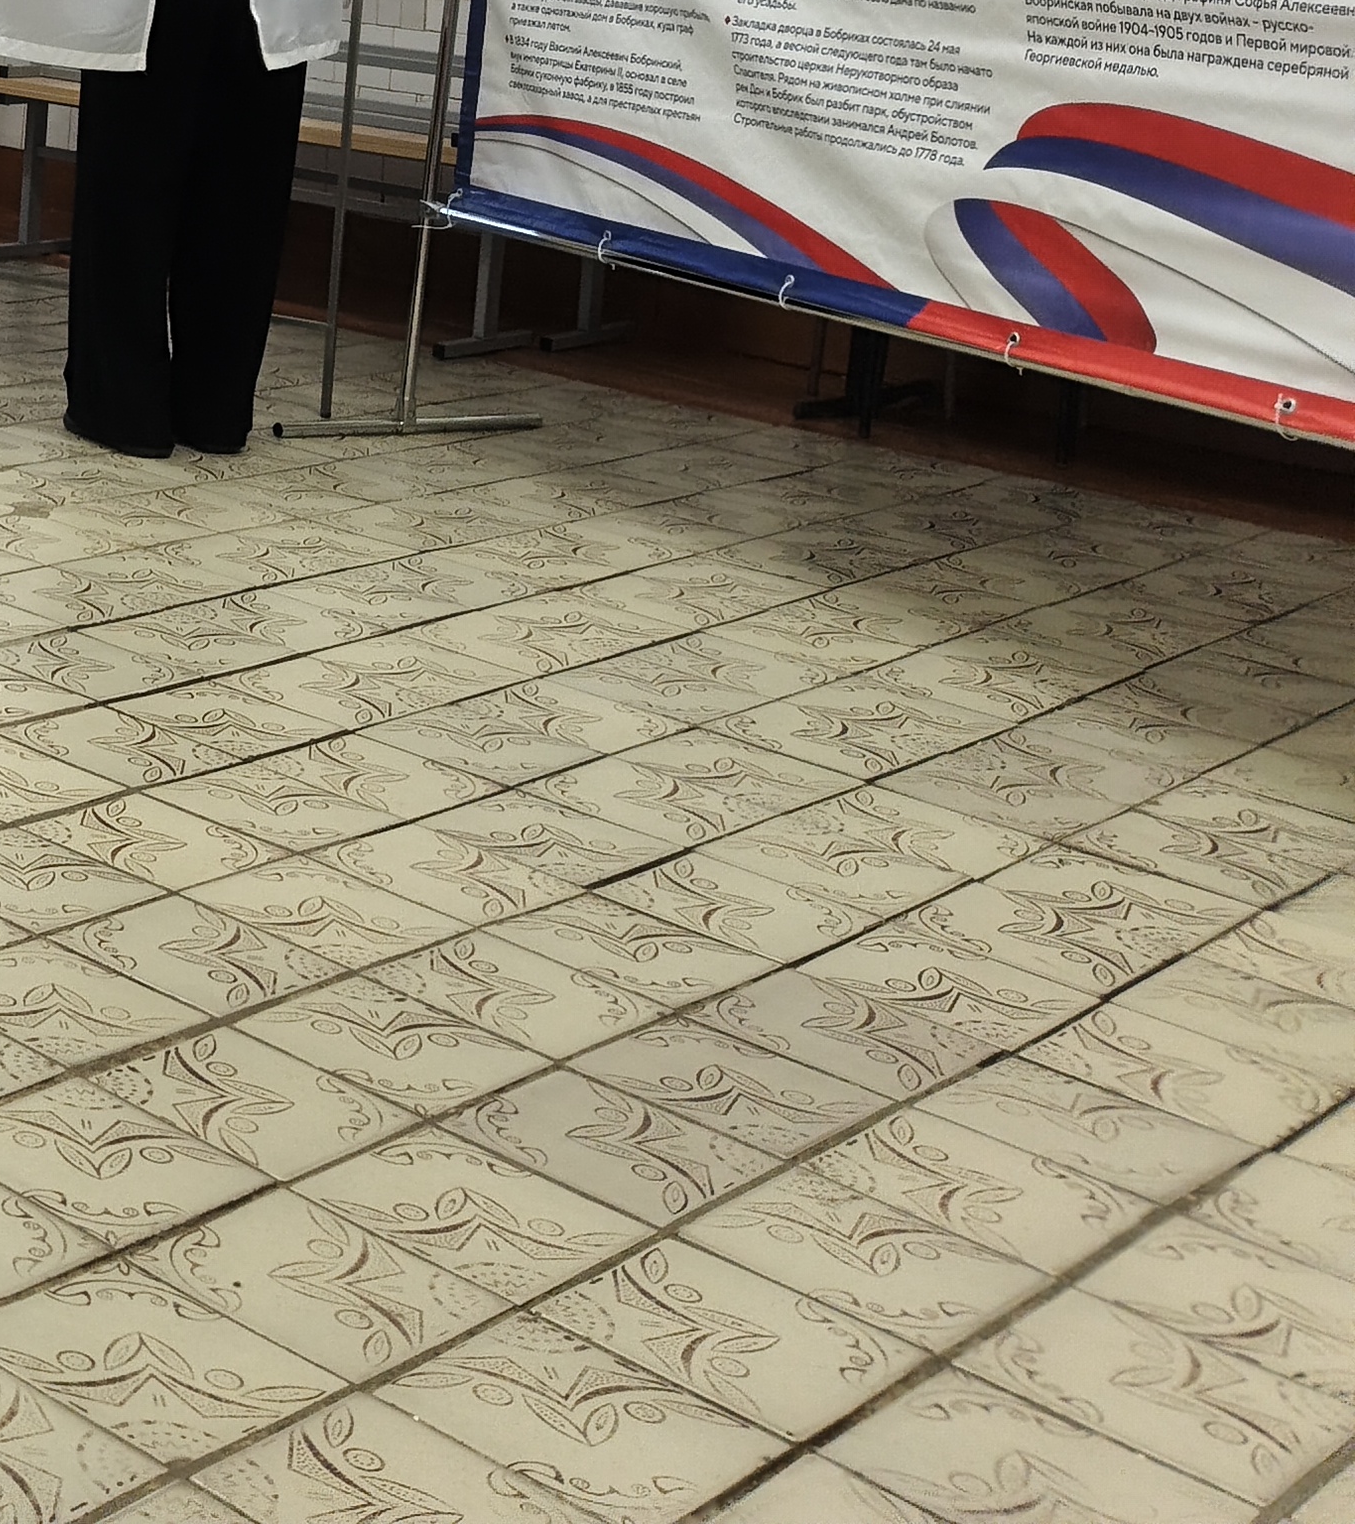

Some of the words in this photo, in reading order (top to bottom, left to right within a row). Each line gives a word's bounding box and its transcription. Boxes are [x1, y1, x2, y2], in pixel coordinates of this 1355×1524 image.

[1026, 14, 1080, 29] японской
[1081, 18, 1117, 33] войне
[1119, 21, 1184, 40] 1904–1905
[1186, 31, 1223, 45] годов
[1225, 35, 1233, 46] и
[1236, 33, 1287, 52] Первой
[1095, 0, 1154, 18] побывала
[1156, 8, 1171, 19] на
[1173, 10, 1203, 25] двух
[1204, 12, 1251, 27] войнах
[1261, 19, 1314, 34] русско-
[1024, 48, 1102, 70] Георгиевской
[1103, 61, 1159, 78] медалью.
[1027, 30, 1043, 44] На
[1044, 35, 1088, 49] каждой
[1090, 40, 1104, 51] из
[1105, 42, 1127, 54] них
[1127, 43, 1150, 56] она
[1153, 44, 1184, 60] была
[1187, 51, 1264, 70] награждена
[1267, 61, 1349, 80] серебряной
